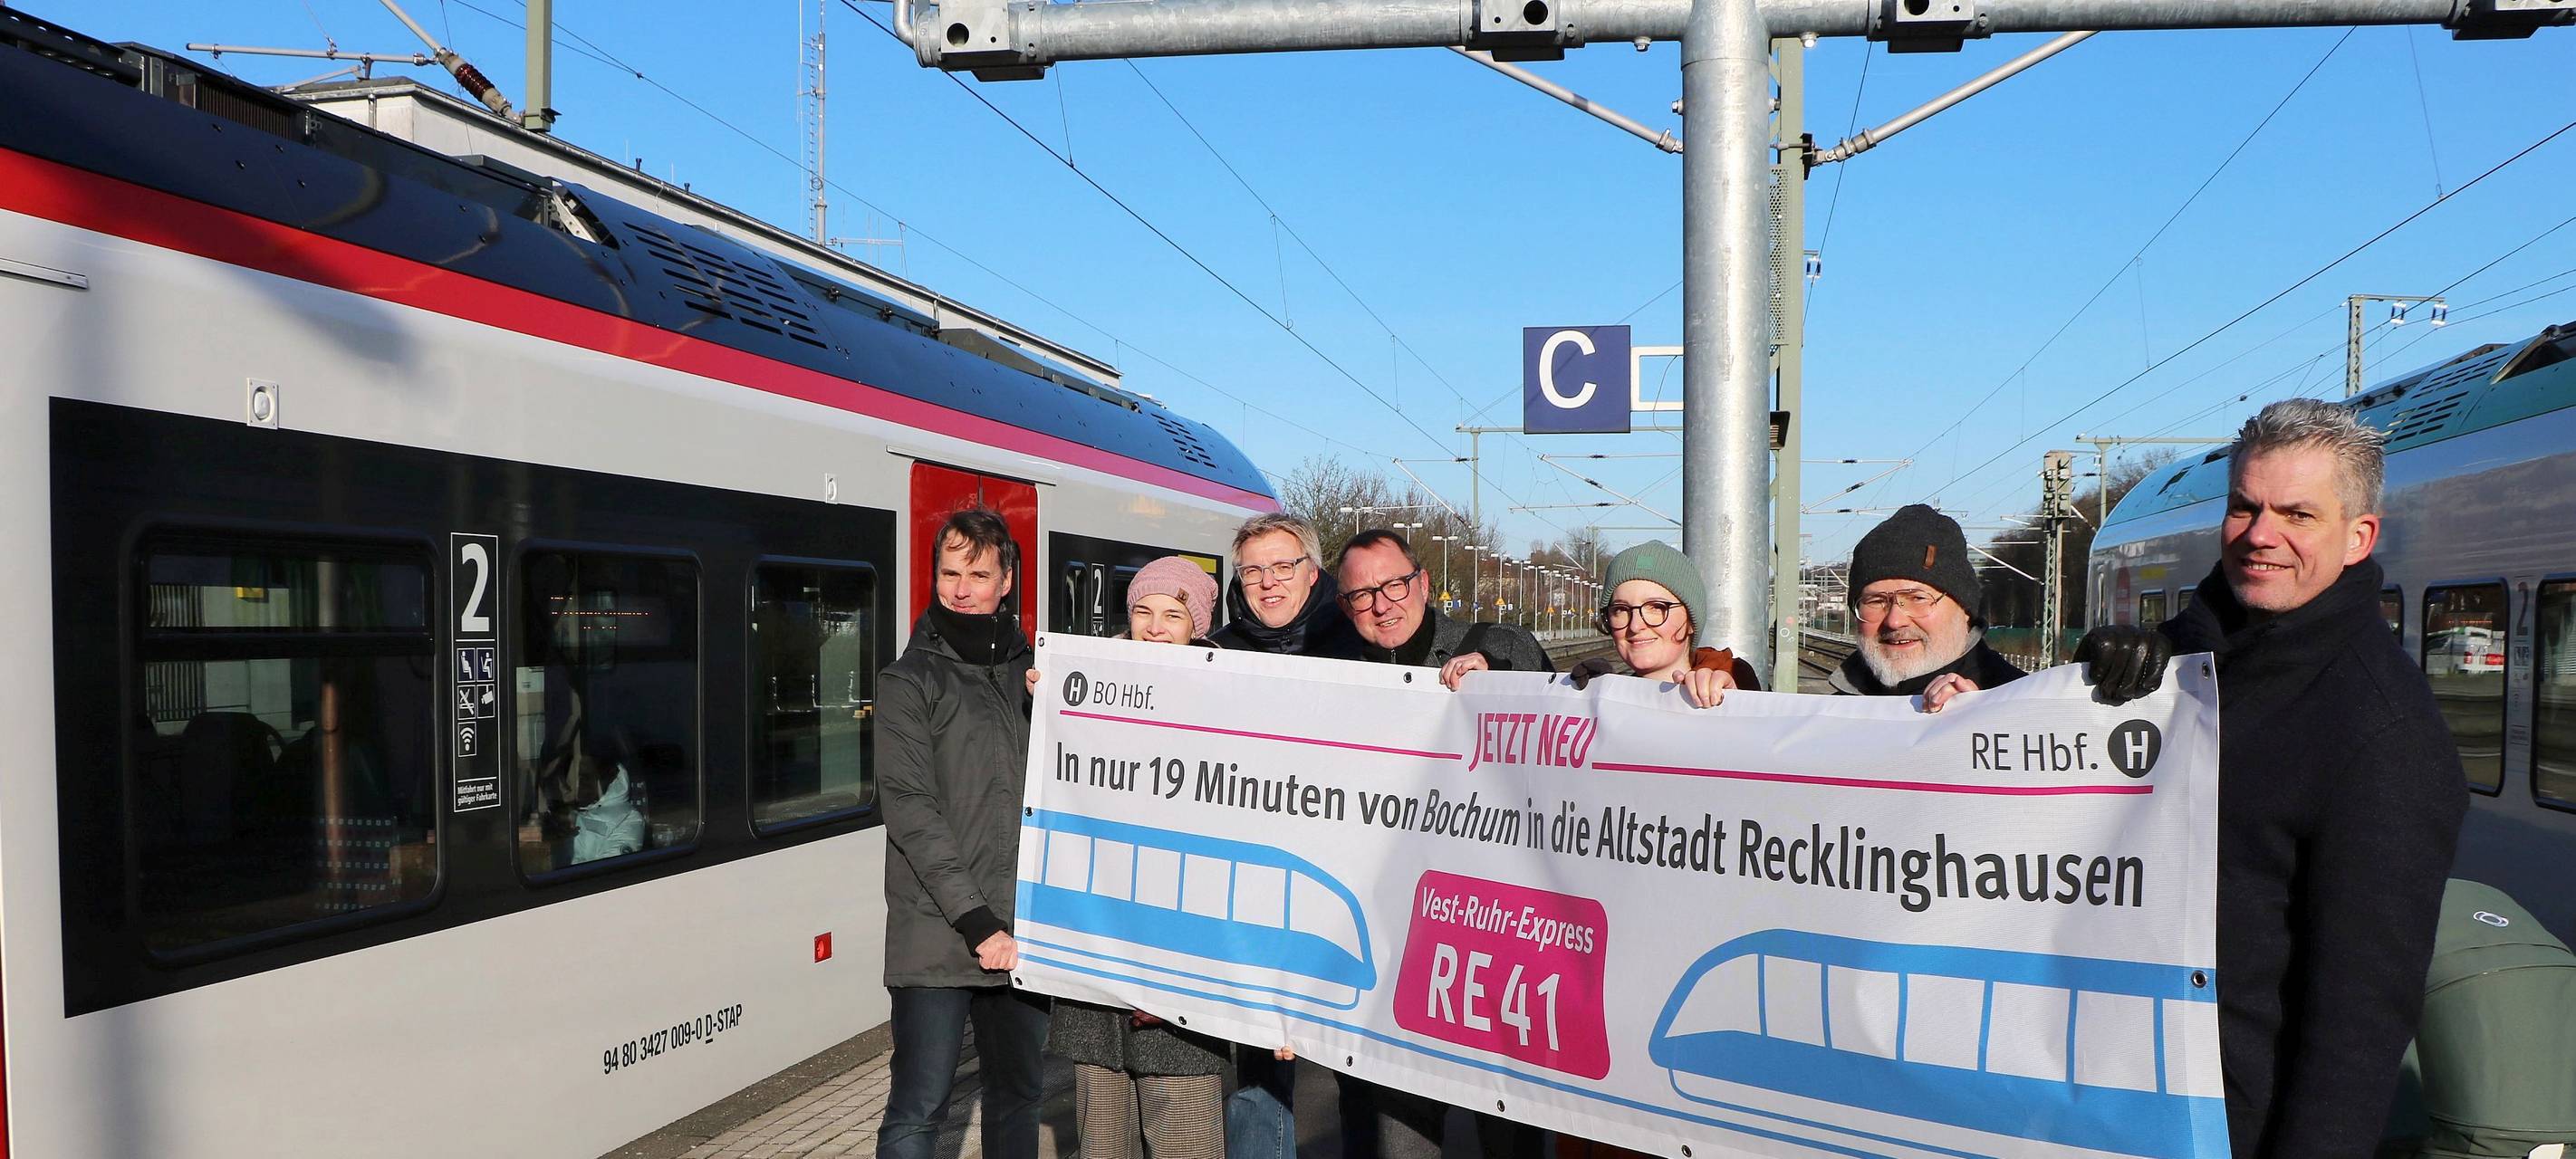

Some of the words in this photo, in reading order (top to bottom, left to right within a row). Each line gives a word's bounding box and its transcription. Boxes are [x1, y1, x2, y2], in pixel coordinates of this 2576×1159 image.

[1539, 330, 1598, 408] C
[461, 542, 489, 632] 2
[1093, 568, 1102, 615] 2
[2516, 581, 2529, 636] 2
[1093, 680, 1118, 706] BO
[1120, 683, 1155, 711] Hbf.
[1468, 713, 1537, 772] JETZT
[1537, 714, 1598, 769] NEU
[1972, 733, 2012, 771] RE
[2023, 733, 2099, 771] Hbf.
[1056, 742, 1079, 783] In
[1090, 755, 1140, 791] nur
[1149, 756, 1186, 800] 19
[1195, 760, 1345, 821] Minuten
[1359, 790, 1418, 830] von
[1420, 789, 1521, 846] Bochum
[1526, 797, 1544, 850] in
[1551, 800, 1591, 857] die
[1596, 806, 1726, 875] Altstadt
[1739, 819, 2143, 912] Recklinghausen
[1421, 886, 1595, 953] Vest-Ruhr-Express
[1427, 942, 1493, 1032] RE
[1500, 963, 1560, 1051] 41
[603, 1047, 619, 1075] 94
[622, 1040, 637, 1068] 80
[639, 1030, 668, 1061] 3427
[671, 1017, 702, 1049] 009-0
[705, 1003, 743, 1041] D-STAP
